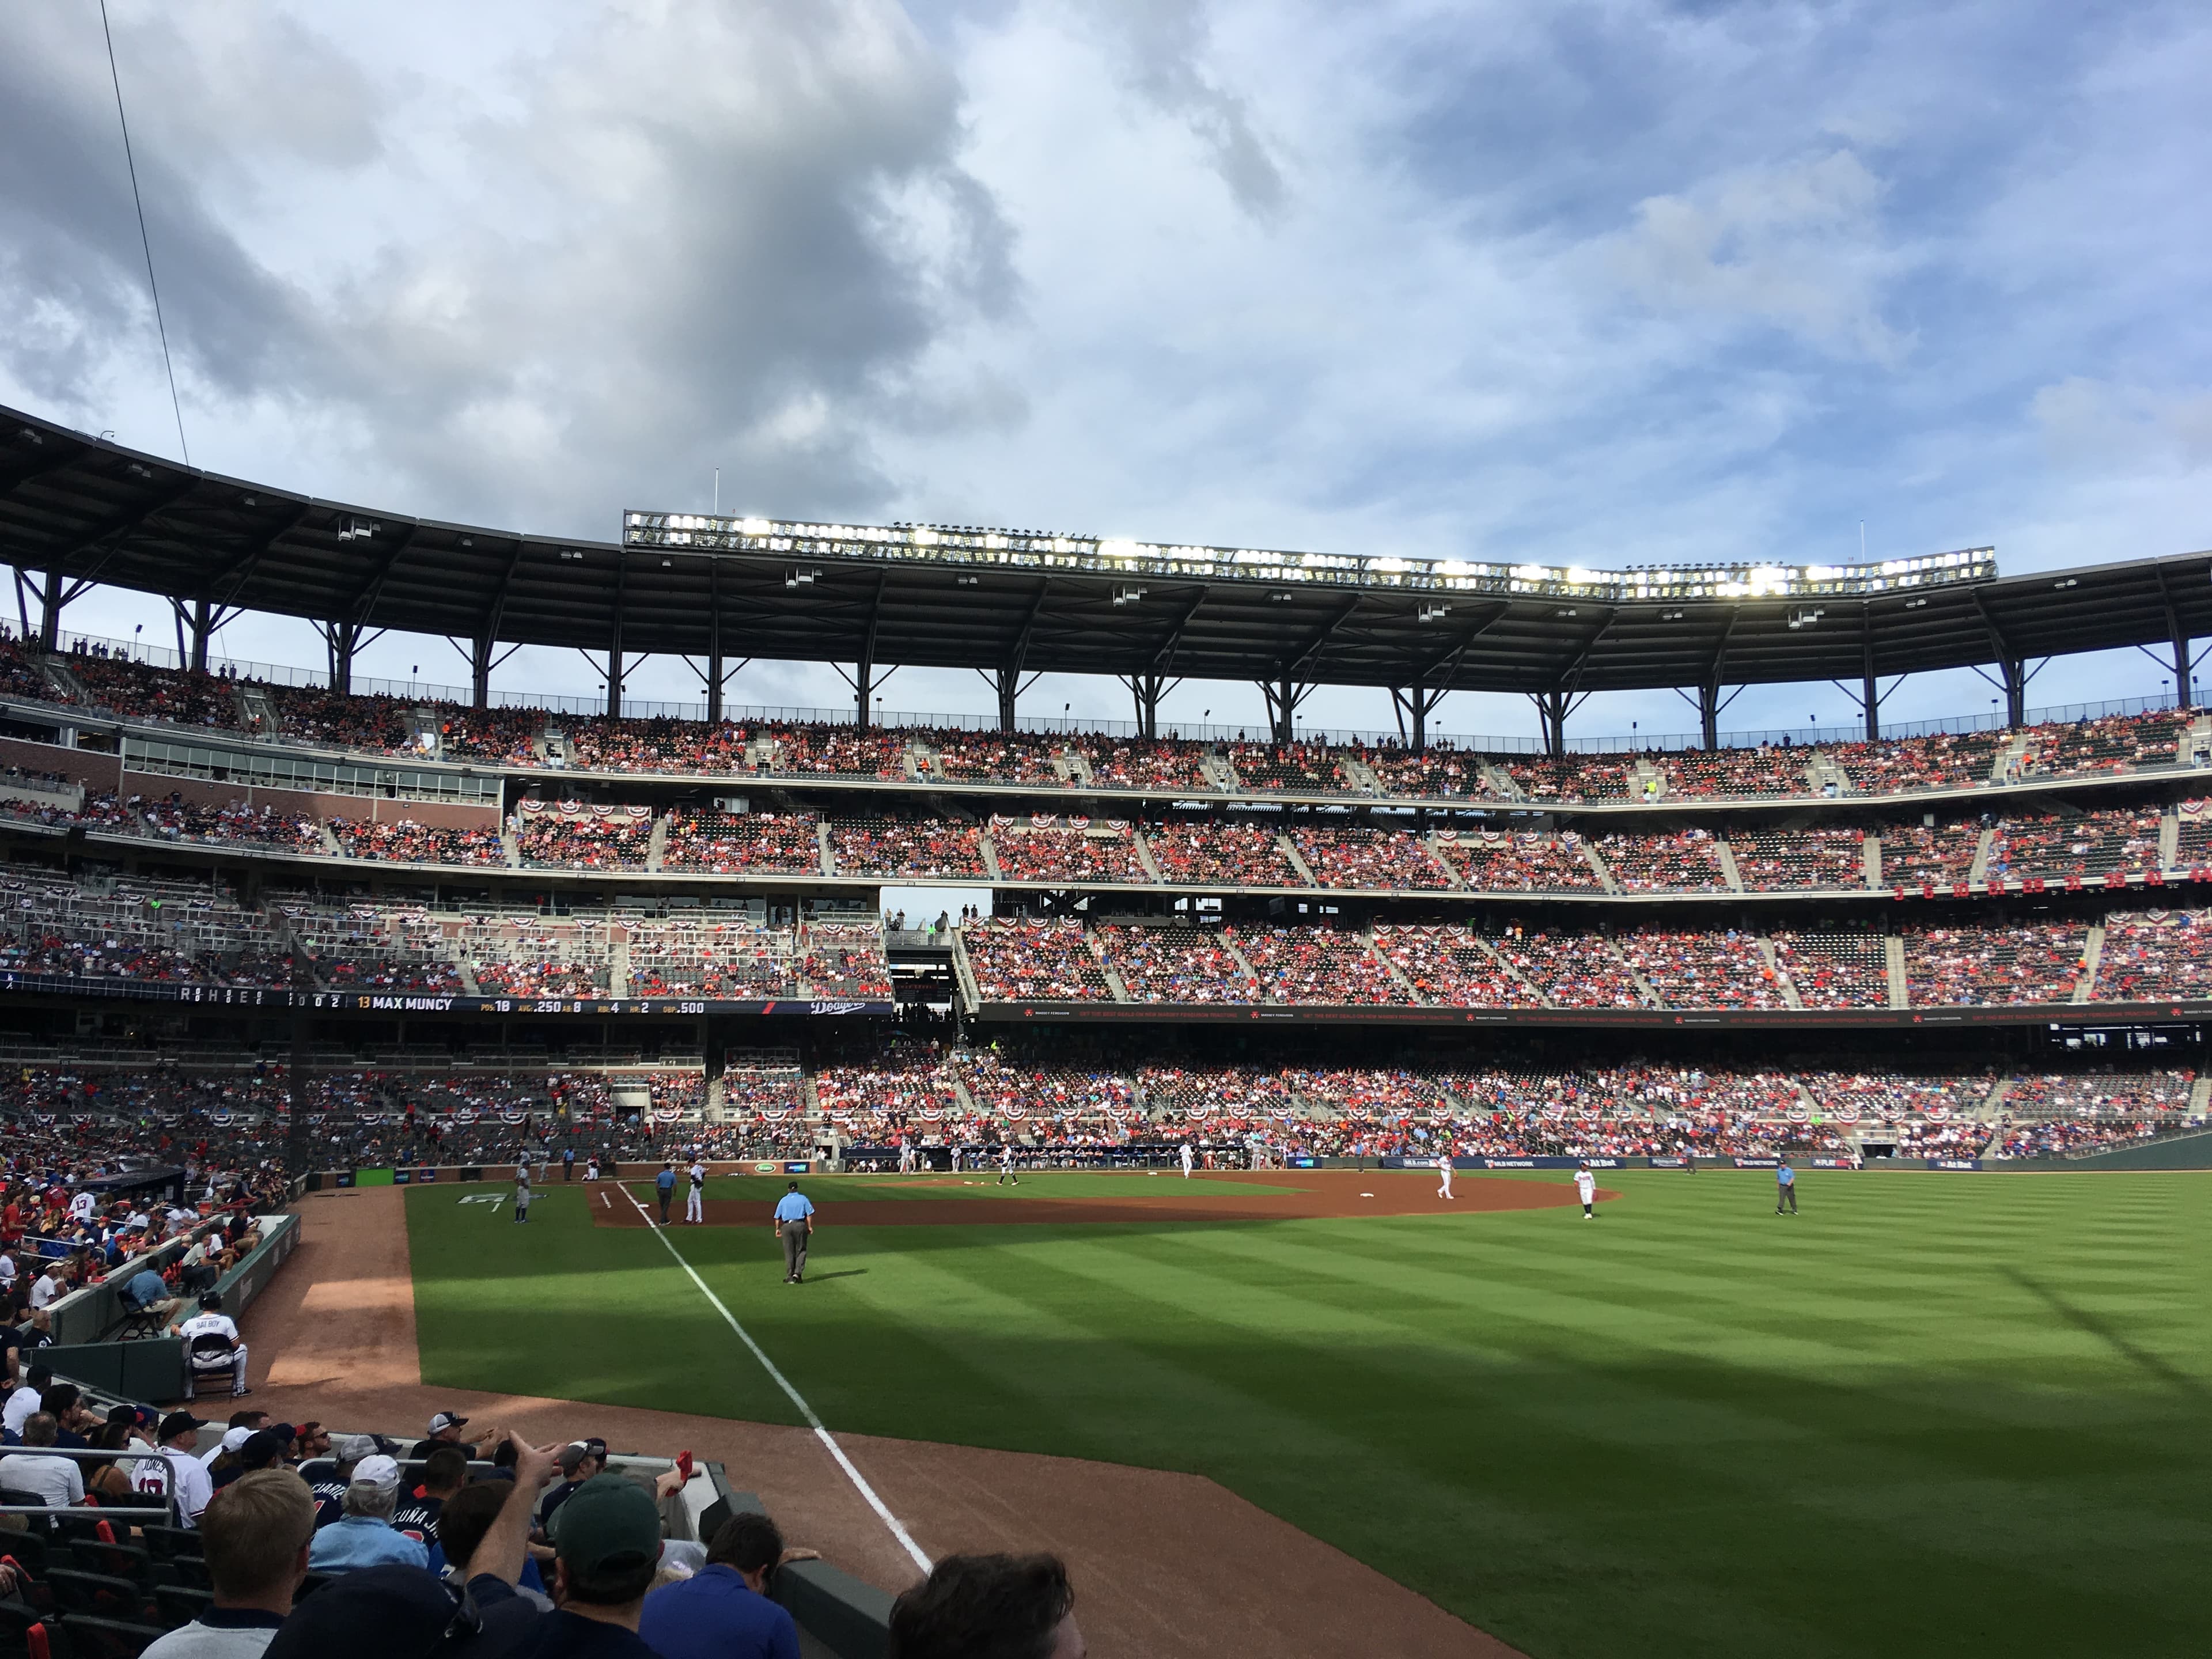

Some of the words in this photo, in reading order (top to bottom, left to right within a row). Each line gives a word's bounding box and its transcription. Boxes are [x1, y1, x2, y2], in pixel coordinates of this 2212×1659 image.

[2104, 873, 2126, 888] 35
[2144, 870, 2164, 886] 41
[2188, 868, 2212, 883] 44
[1953, 882, 1969, 897] 10
[1988, 881, 2006, 895] 21
[2022, 878, 2044, 893] 29
[2064, 876, 2082, 891] 31
[1894, 887, 1904, 900] 3
[1923, 885, 1934, 899] 6
[180, 987, 190, 1000] R
[209, 989, 218, 1002] H
[240, 991, 248, 1003] E
[331, 998, 339, 1007] 2
[358, 997, 370, 1008] 13
[373, 997, 403, 1009] MAX
[405, 998, 453, 1010] MUNCY
[533, 1001, 561, 1013] .250
[611, 1002, 620, 1013] 4
[641, 1002, 649, 1013] 2
[677, 1002, 704, 1014] .500
[1590, 1159, 1601, 1167] At
[1600, 1159, 1618, 1167] Bat
[76, 1199, 88, 1211] 13
[196, 1320, 207, 1330] BAT
[207, 1320, 221, 1328] BOY
[142, 1458, 165, 1474] JONES
